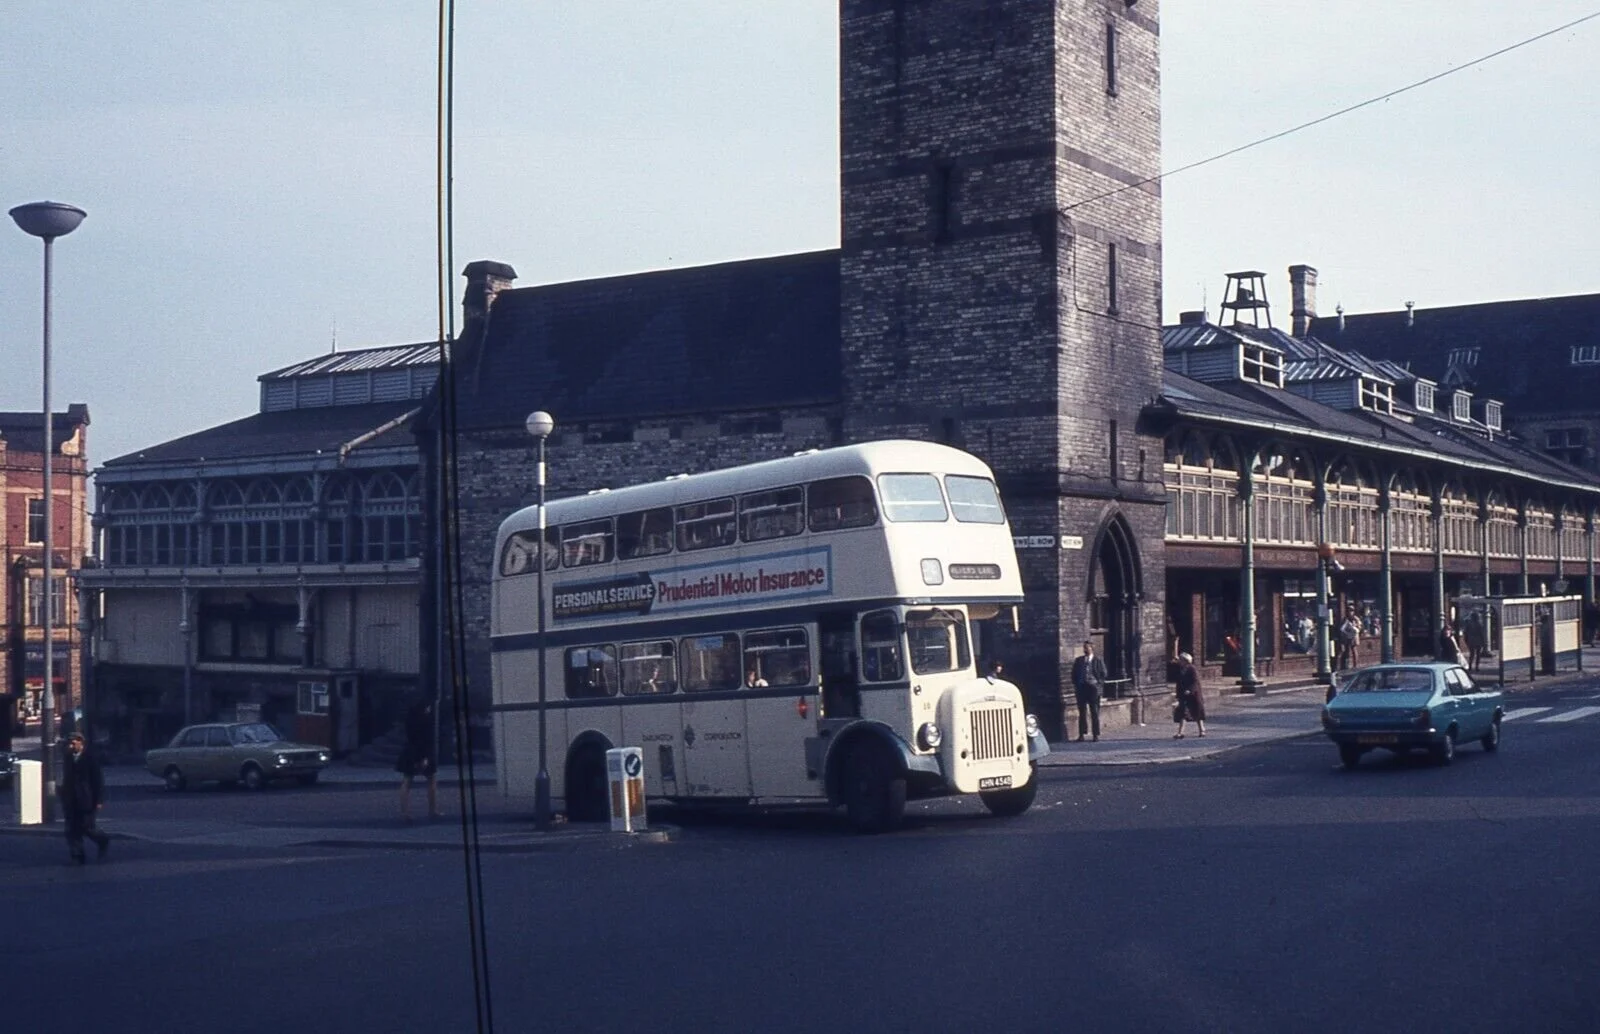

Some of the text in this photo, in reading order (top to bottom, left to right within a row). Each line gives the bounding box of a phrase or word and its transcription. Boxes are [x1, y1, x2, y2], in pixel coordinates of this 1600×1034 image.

[555, 589, 609, 609] PERSONAL
[609, 583, 653, 602] SERVICE
[660, 567, 825, 603] Prudential Motor Insurance
[981, 778, 994, 788] AHN
